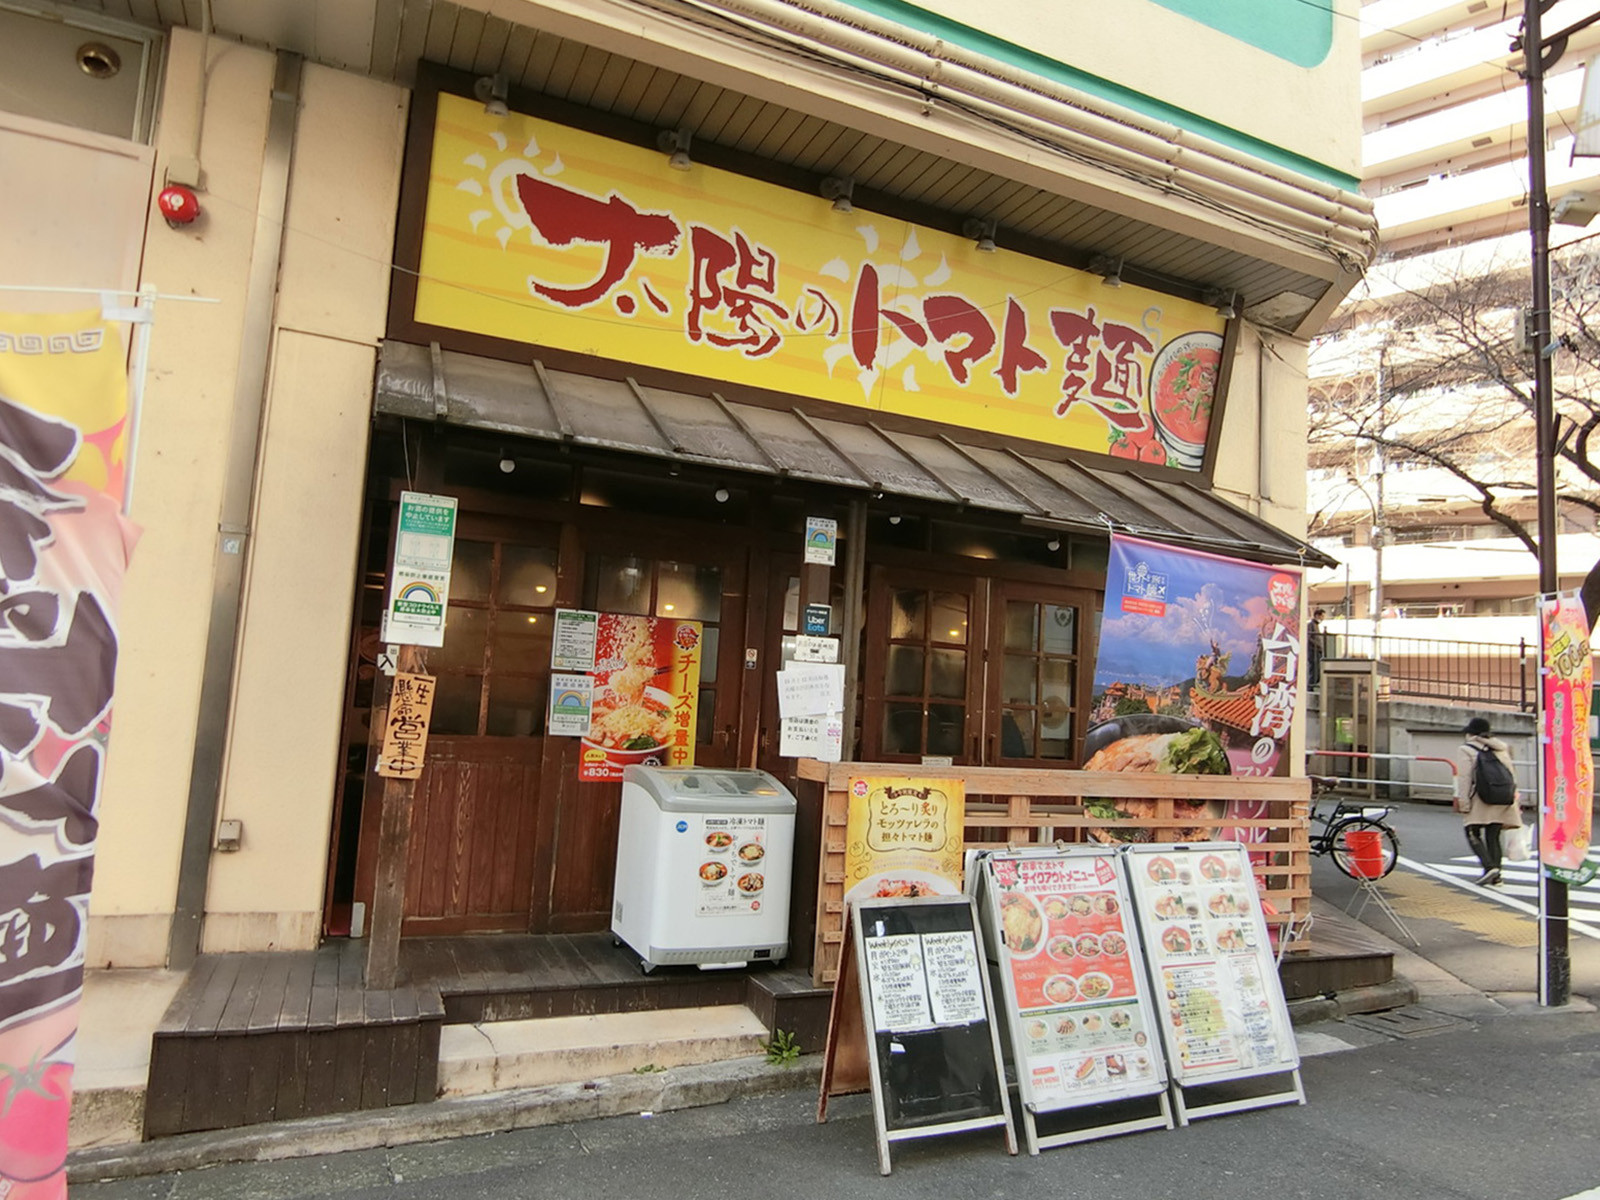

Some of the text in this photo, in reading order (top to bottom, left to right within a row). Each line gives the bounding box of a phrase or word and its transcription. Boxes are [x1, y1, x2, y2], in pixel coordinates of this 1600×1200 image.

[517, 172, 1155, 431] 太陽のトマト麺
[807, 616, 825, 625] Uber
[807, 623, 825, 632] Eats
[672, 653, 697, 765] チーズ増量中
[877, 818, 939, 829] モッツァレラの
[1022, 871, 1095, 884] テイクアウトメニュー
